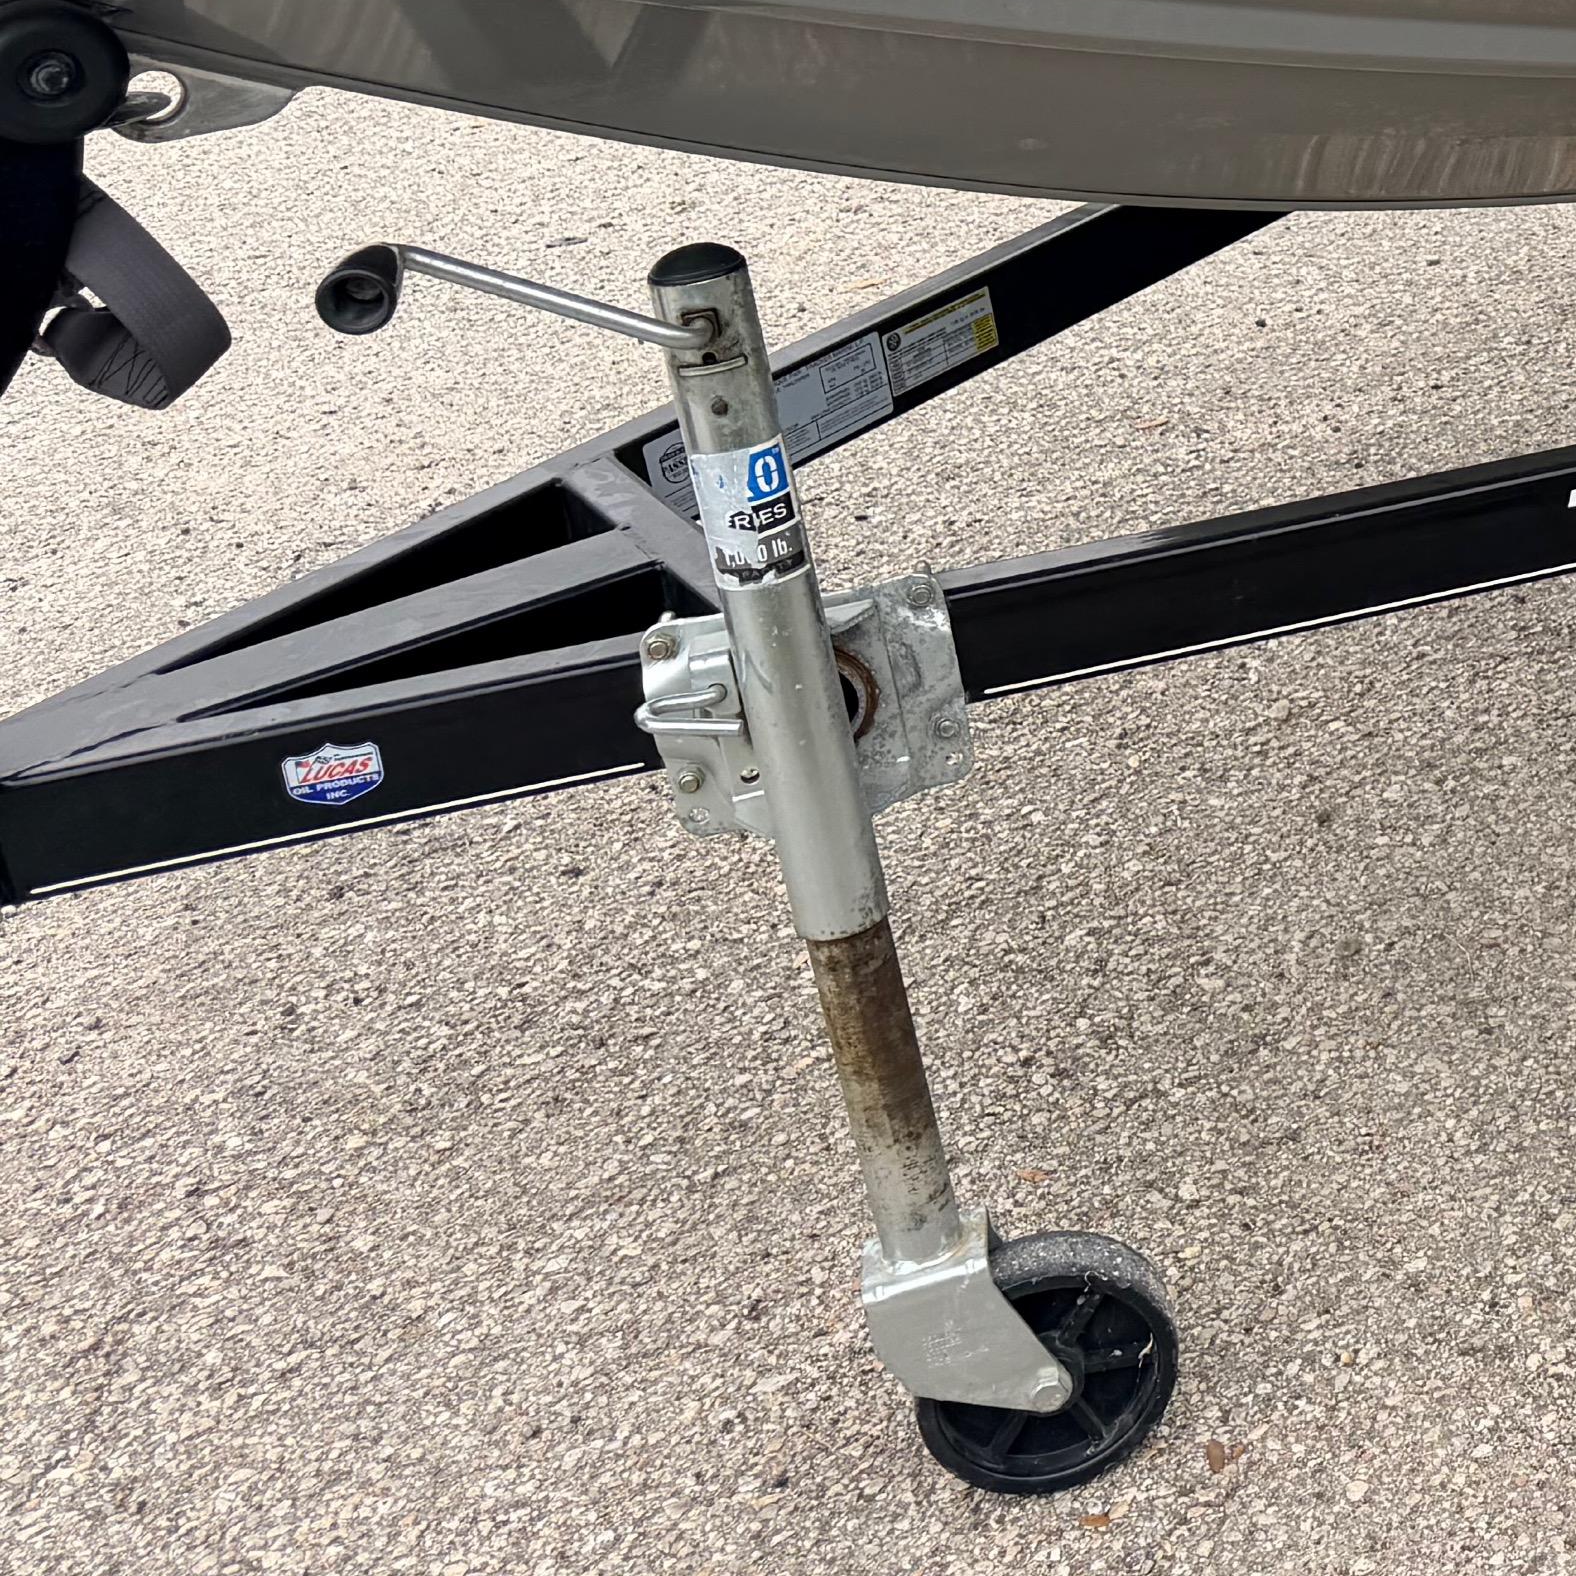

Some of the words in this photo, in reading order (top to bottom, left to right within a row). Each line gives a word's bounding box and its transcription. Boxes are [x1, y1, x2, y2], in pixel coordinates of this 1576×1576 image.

[729, 503, 787, 530] RIES
[771, 538, 793, 558] lb.
[301, 757, 373, 784] LUCAS
[293, 785, 315, 796] OIL
[316, 774, 380, 792] PRODUCTS
